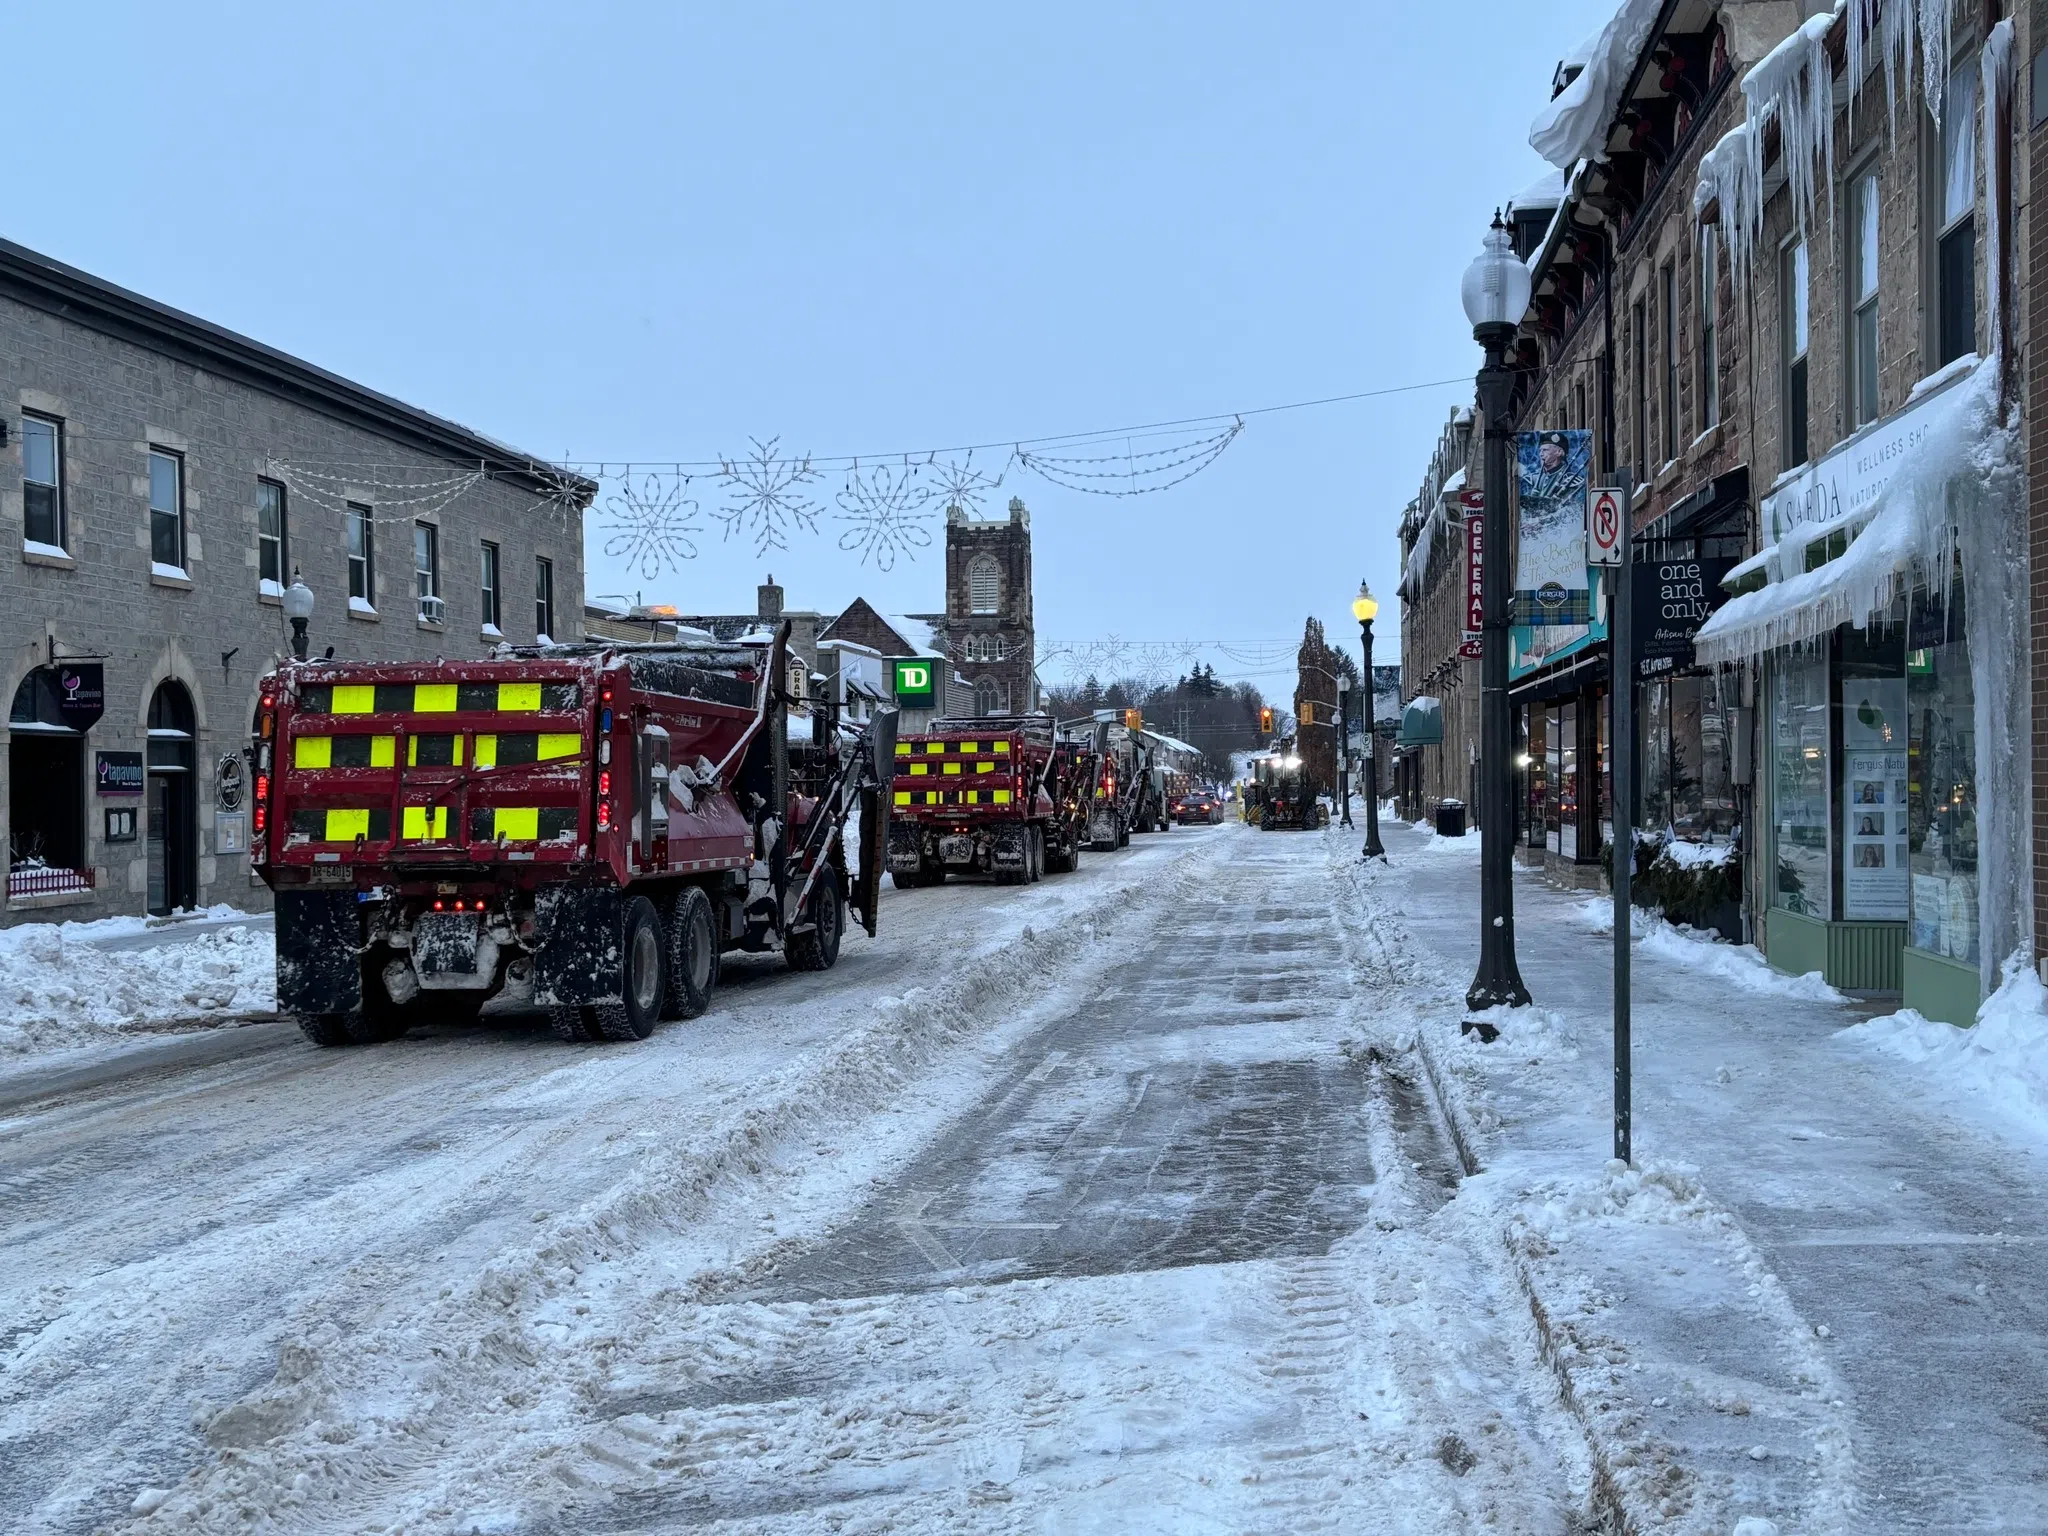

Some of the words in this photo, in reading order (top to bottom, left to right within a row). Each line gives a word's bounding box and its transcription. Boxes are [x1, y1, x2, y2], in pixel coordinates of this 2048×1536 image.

[1856, 438, 1904, 475] WELLNESS
[1472, 520, 1483, 627] GENERAL
[1660, 563, 1700, 580] one
[1538, 591, 1566, 599] FERGUS
[1661, 577, 1705, 599] and
[1662, 597, 1710, 621] only
[1655, 627, 1684, 640] Artisan
[899, 667, 928, 687] TD
[75, 687, 102, 700] tapavino
[108, 760, 142, 785] tapavino
[1852, 758, 1883, 771] Fergus
